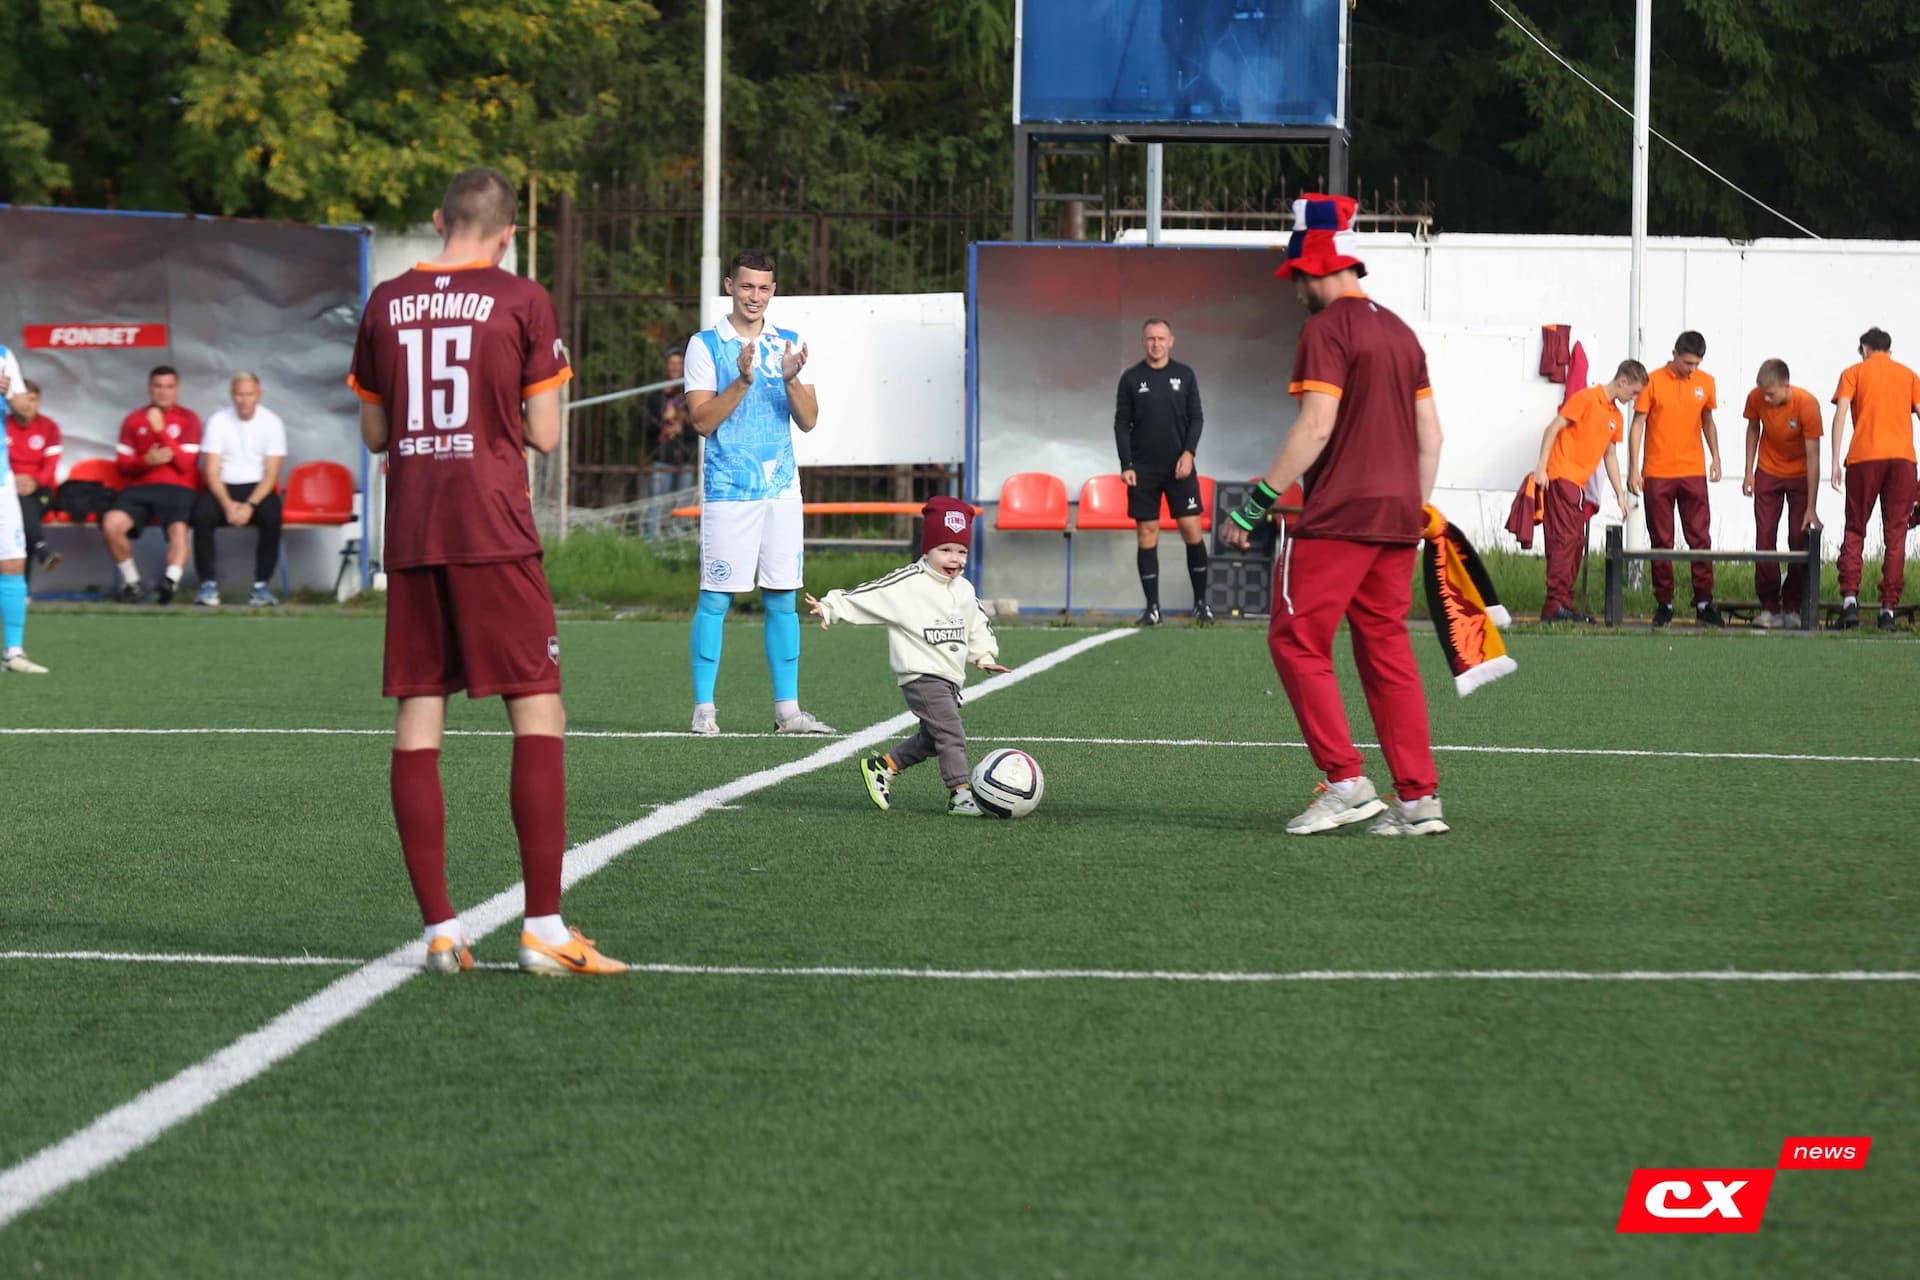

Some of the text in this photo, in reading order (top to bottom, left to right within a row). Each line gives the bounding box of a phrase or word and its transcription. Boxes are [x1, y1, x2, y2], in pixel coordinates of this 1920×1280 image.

[389, 292, 495, 326] АБРАМОВ
[49, 327, 140, 346] FONBET
[398, 325, 473, 432] 15
[398, 433, 474, 456] SEUS
